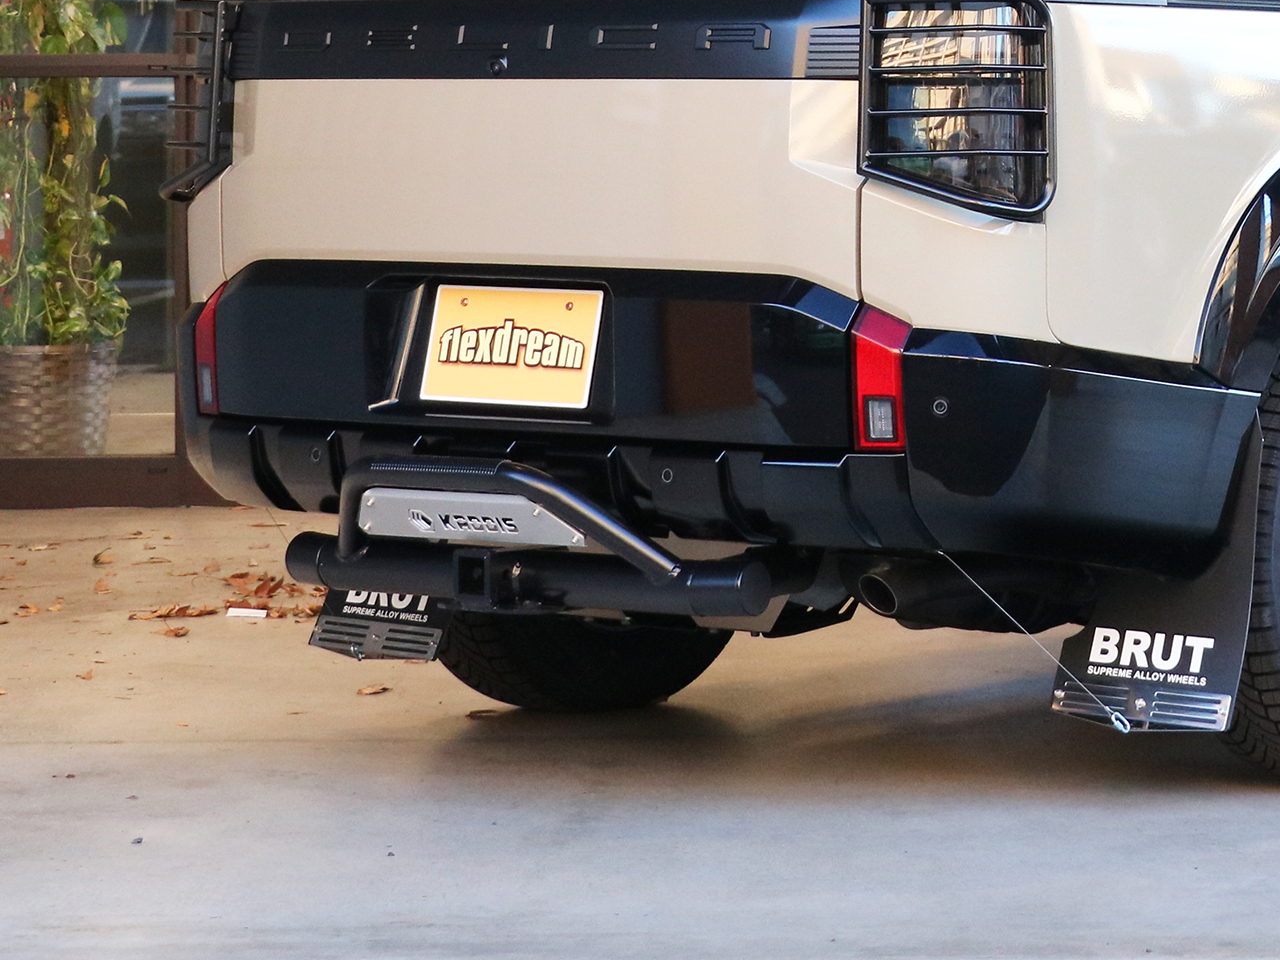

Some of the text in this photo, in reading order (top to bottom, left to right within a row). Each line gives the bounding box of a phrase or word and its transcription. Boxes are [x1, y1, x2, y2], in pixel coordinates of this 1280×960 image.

[277, 23, 773, 52] DELICA
[438, 318, 585, 370] flexdream
[342, 605, 429, 622] SUPREME ALLOY WHEELS
[1088, 626, 1215, 674] BRUT
[1087, 665, 1207, 687] SUPREME ALLOY WHEELS
